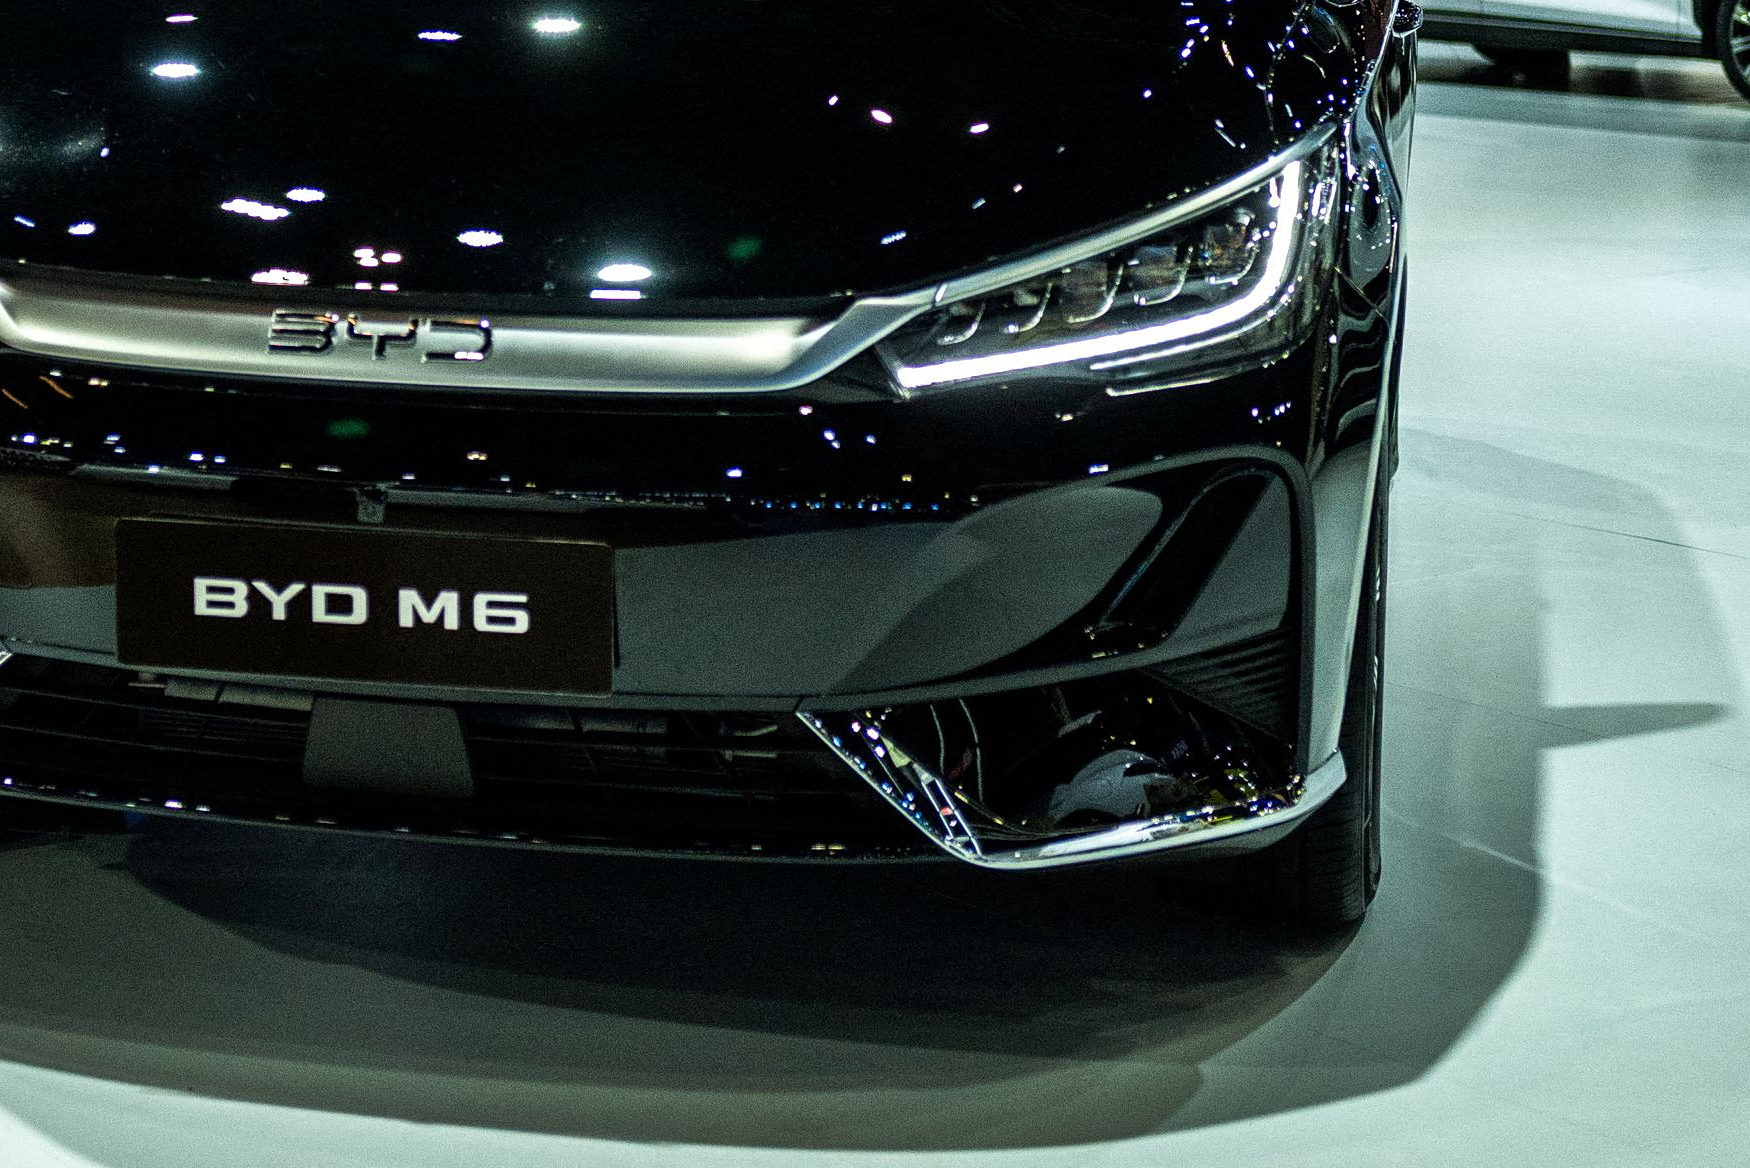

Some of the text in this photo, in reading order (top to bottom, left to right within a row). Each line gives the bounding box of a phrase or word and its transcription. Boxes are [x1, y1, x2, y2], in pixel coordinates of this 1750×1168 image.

[266, 309, 492, 363] BYD
[193, 577, 529, 634] BYD M6
